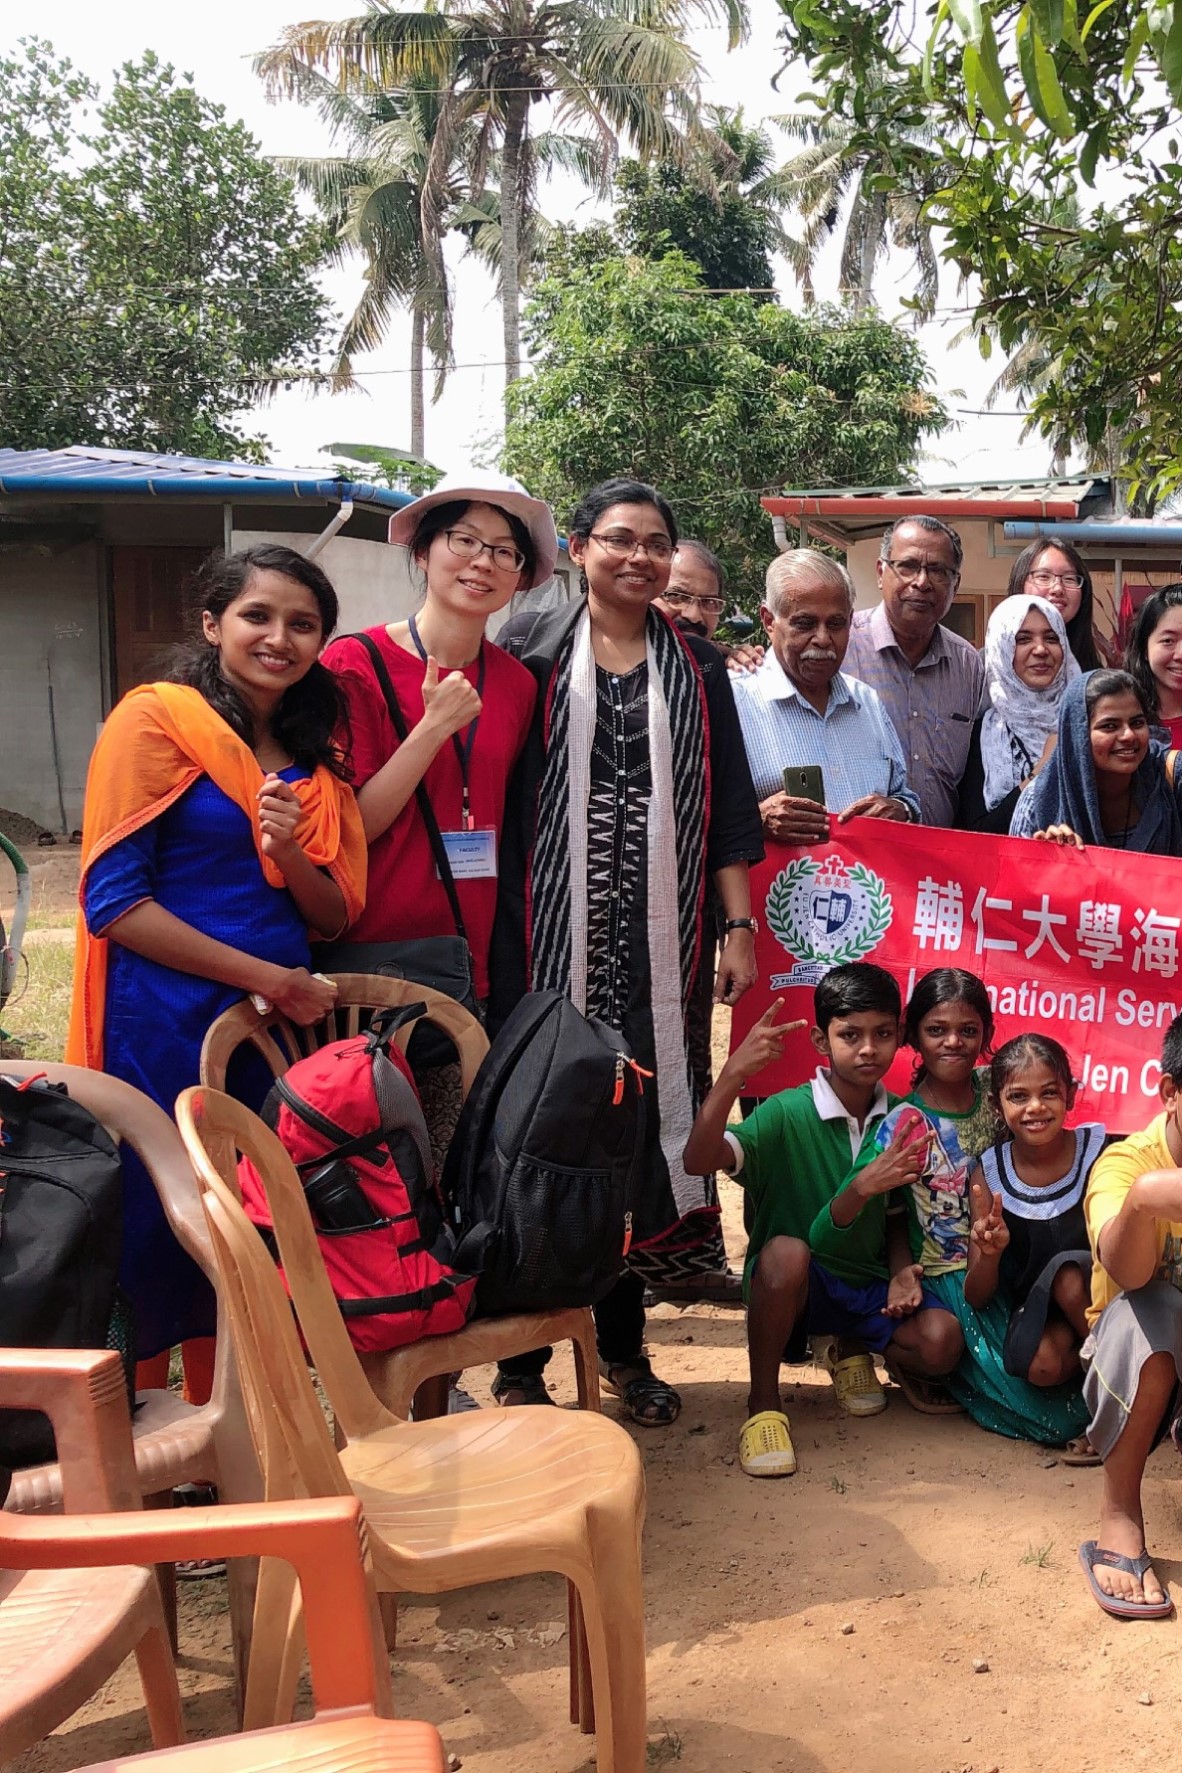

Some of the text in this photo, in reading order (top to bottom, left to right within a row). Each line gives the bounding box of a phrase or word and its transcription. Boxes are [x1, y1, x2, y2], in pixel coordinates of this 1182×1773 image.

[807, 920, 837, 942] CATHOLIC
[837, 899, 859, 936] UNIVERSITY
[906, 968, 1104, 1024] Inational
[1072, 1055, 1129, 1095] Jen
